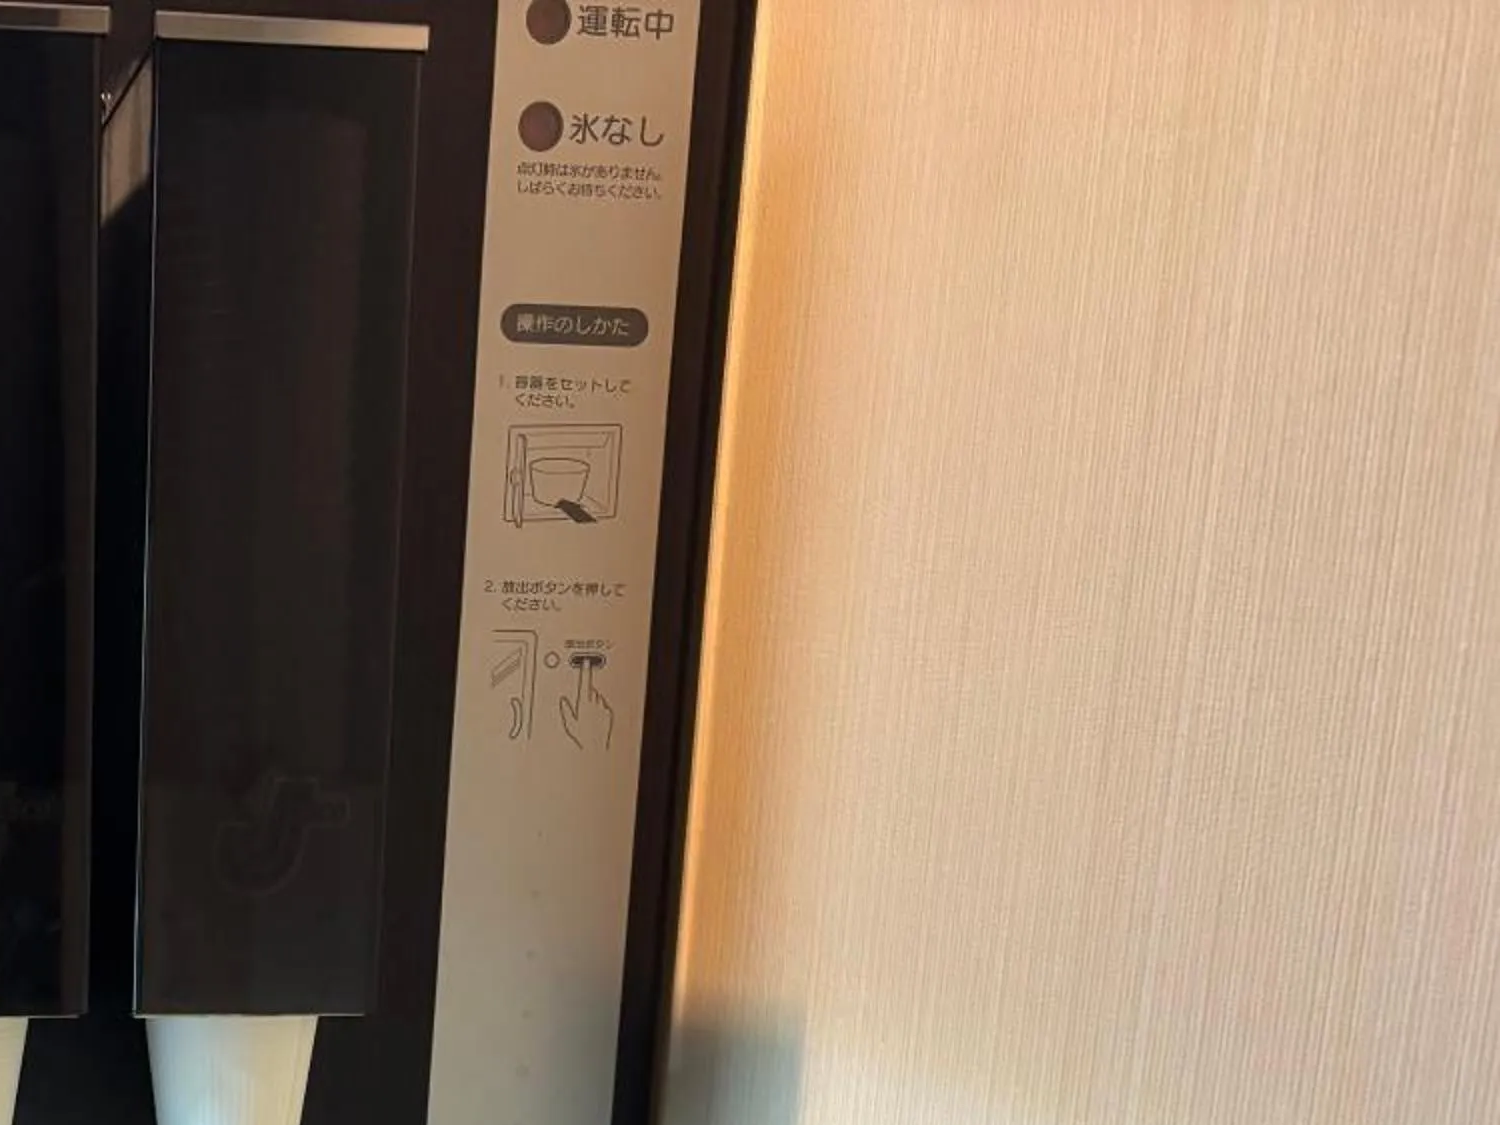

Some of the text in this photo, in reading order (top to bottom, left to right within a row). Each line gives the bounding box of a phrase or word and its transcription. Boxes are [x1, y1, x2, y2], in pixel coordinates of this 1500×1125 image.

[576, 5, 675, 40] 運転中
[569, 113, 665, 147] 氷なし
[516, 312, 630, 336] 操作のしかた
